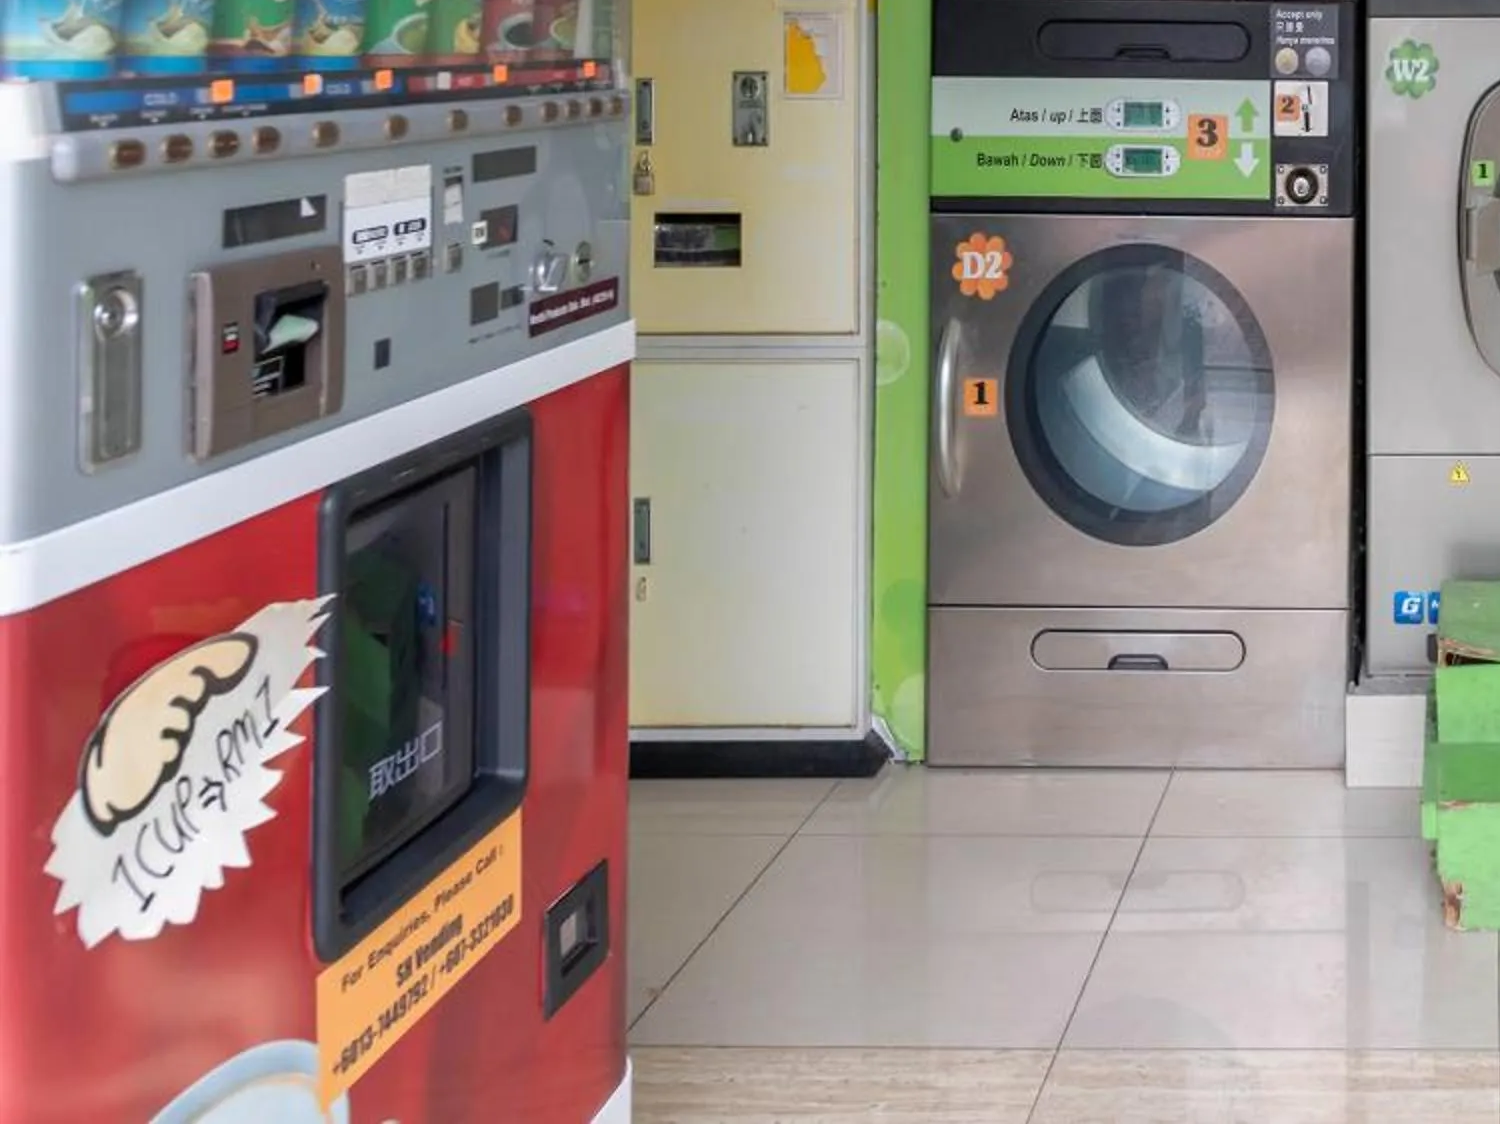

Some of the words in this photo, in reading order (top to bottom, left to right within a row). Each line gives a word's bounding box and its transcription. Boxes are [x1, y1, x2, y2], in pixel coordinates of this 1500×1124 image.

[1392, 59, 1429, 84] W2
[1010, 108, 1038, 123] Atas
[1050, 110, 1067, 126] up
[1280, 96, 1295, 115] 2
[1196, 117, 1219, 148] 3
[977, 153, 1018, 168] Bawah
[1030, 153, 1065, 167] Down
[1478, 163, 1488, 179] 1
[962, 251, 1004, 280] D2
[973, 381, 988, 405] 1
[341, 966, 363, 993] For
[434, 872, 473, 912] Please
[475, 847, 498, 875] Call
